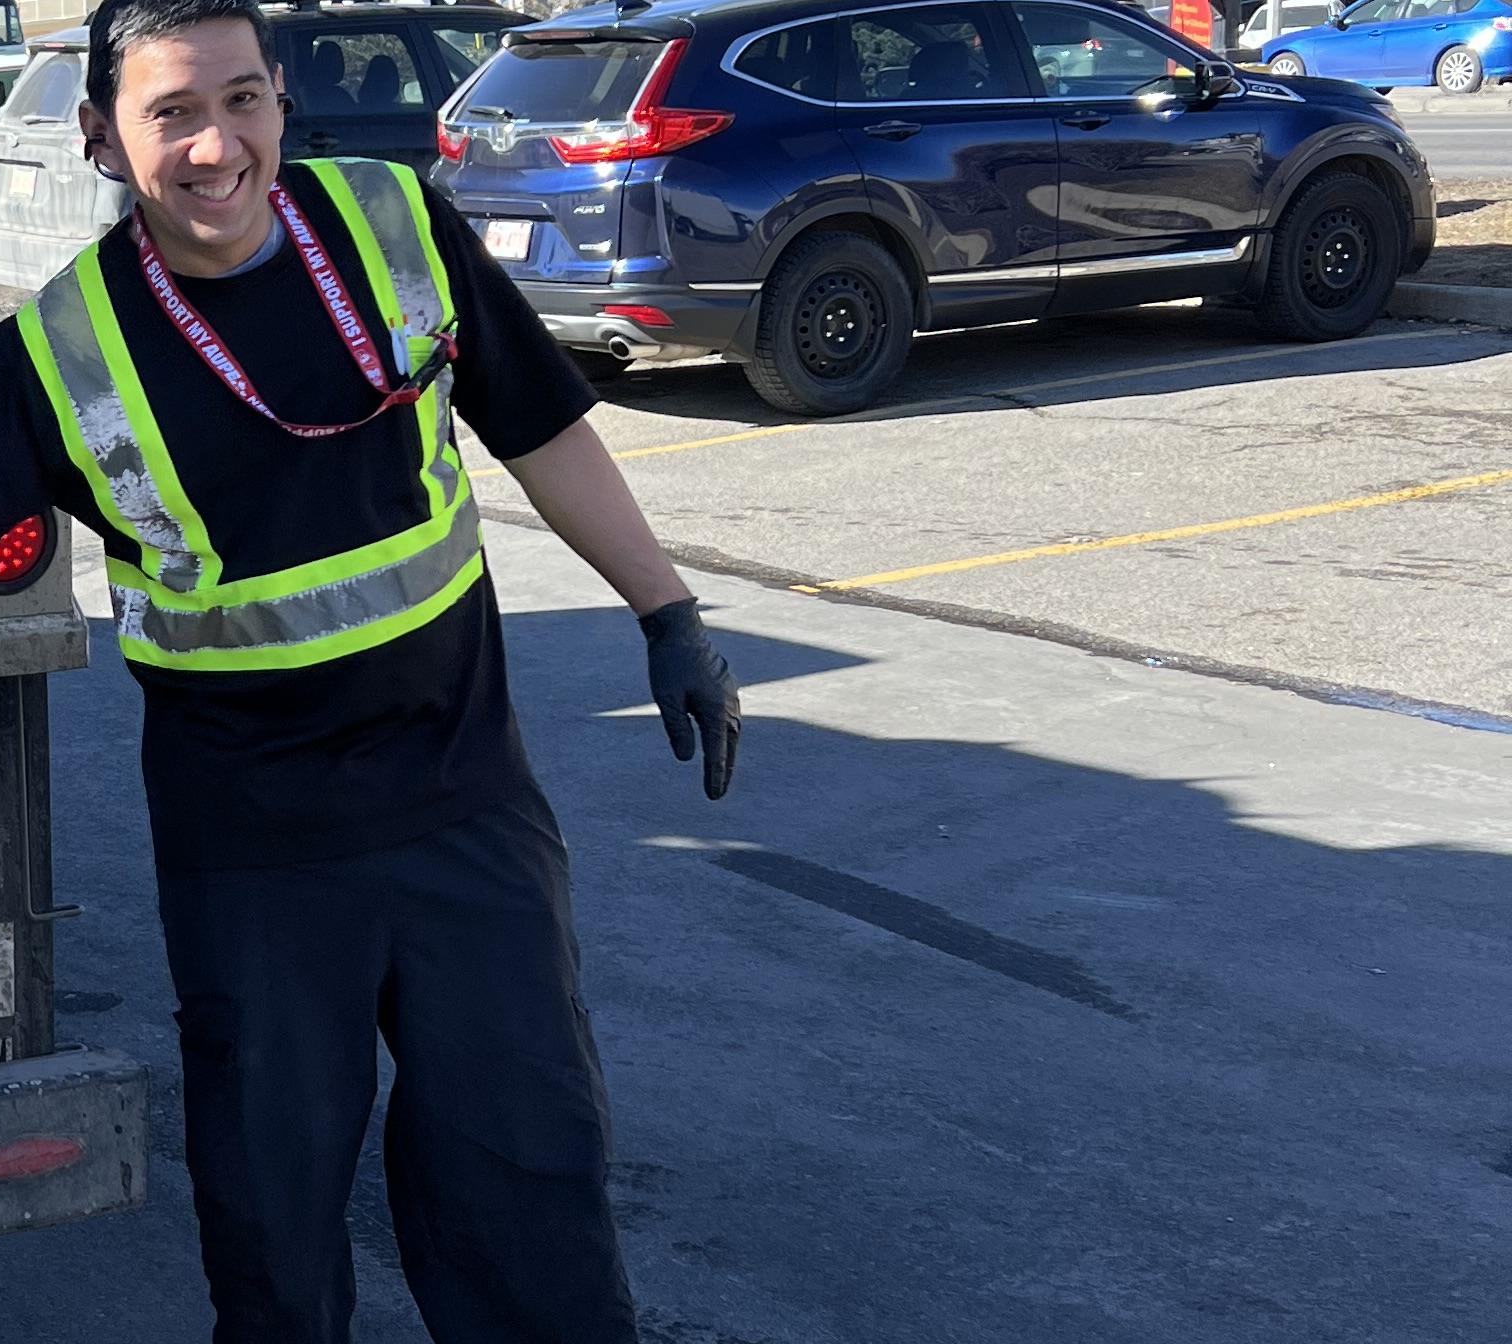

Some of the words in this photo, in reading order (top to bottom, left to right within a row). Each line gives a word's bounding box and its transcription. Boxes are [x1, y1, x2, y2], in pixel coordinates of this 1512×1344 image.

[303, 246, 327, 270] MY
[146, 260, 193, 325] SUPPORT
[185, 320, 212, 346] MY
[315, 269, 362, 338] SUPPORT
